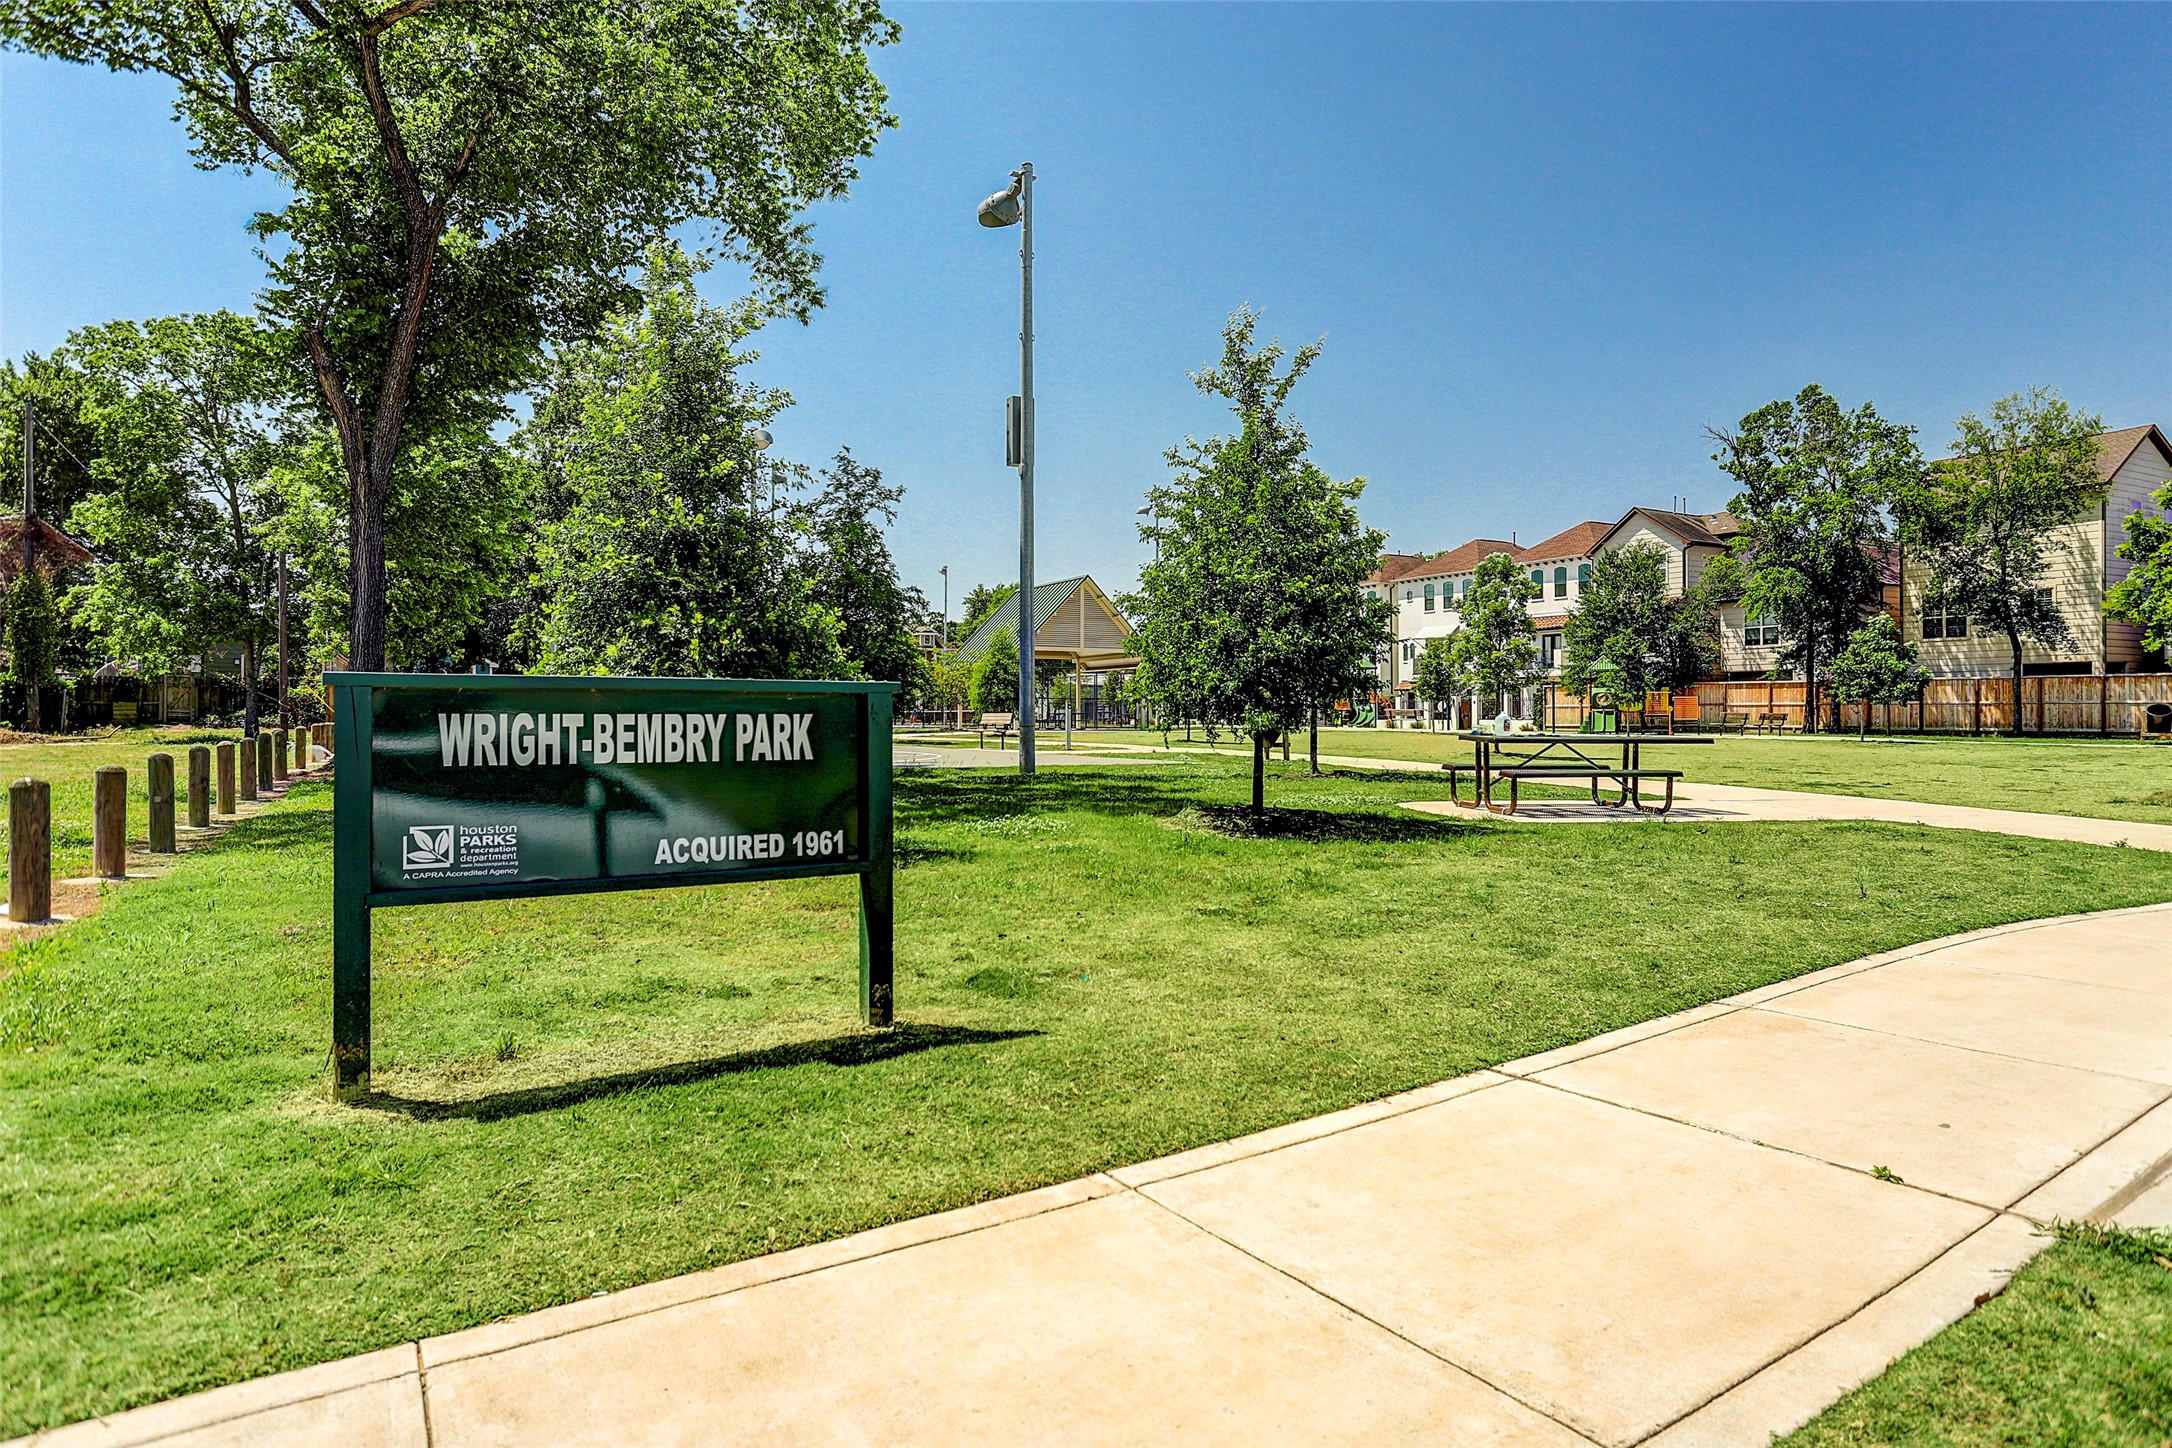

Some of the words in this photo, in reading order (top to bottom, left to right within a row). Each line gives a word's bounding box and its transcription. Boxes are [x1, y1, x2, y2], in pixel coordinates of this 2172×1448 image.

[438, 712, 727, 767] WRIGHT-BEMBRY
[736, 713, 814, 762] PARK
[460, 824, 517, 835] houston
[460, 834, 517, 847] PARKS
[471, 846, 517, 854] recreation
[654, 833, 784, 865] ACQUIRED
[791, 830, 845, 857] 1961
[460, 852, 517, 863] department
[412, 871, 445, 879] CAPRA
[445, 869, 488, 878] Accredited
[489, 868, 519, 876] Agency
